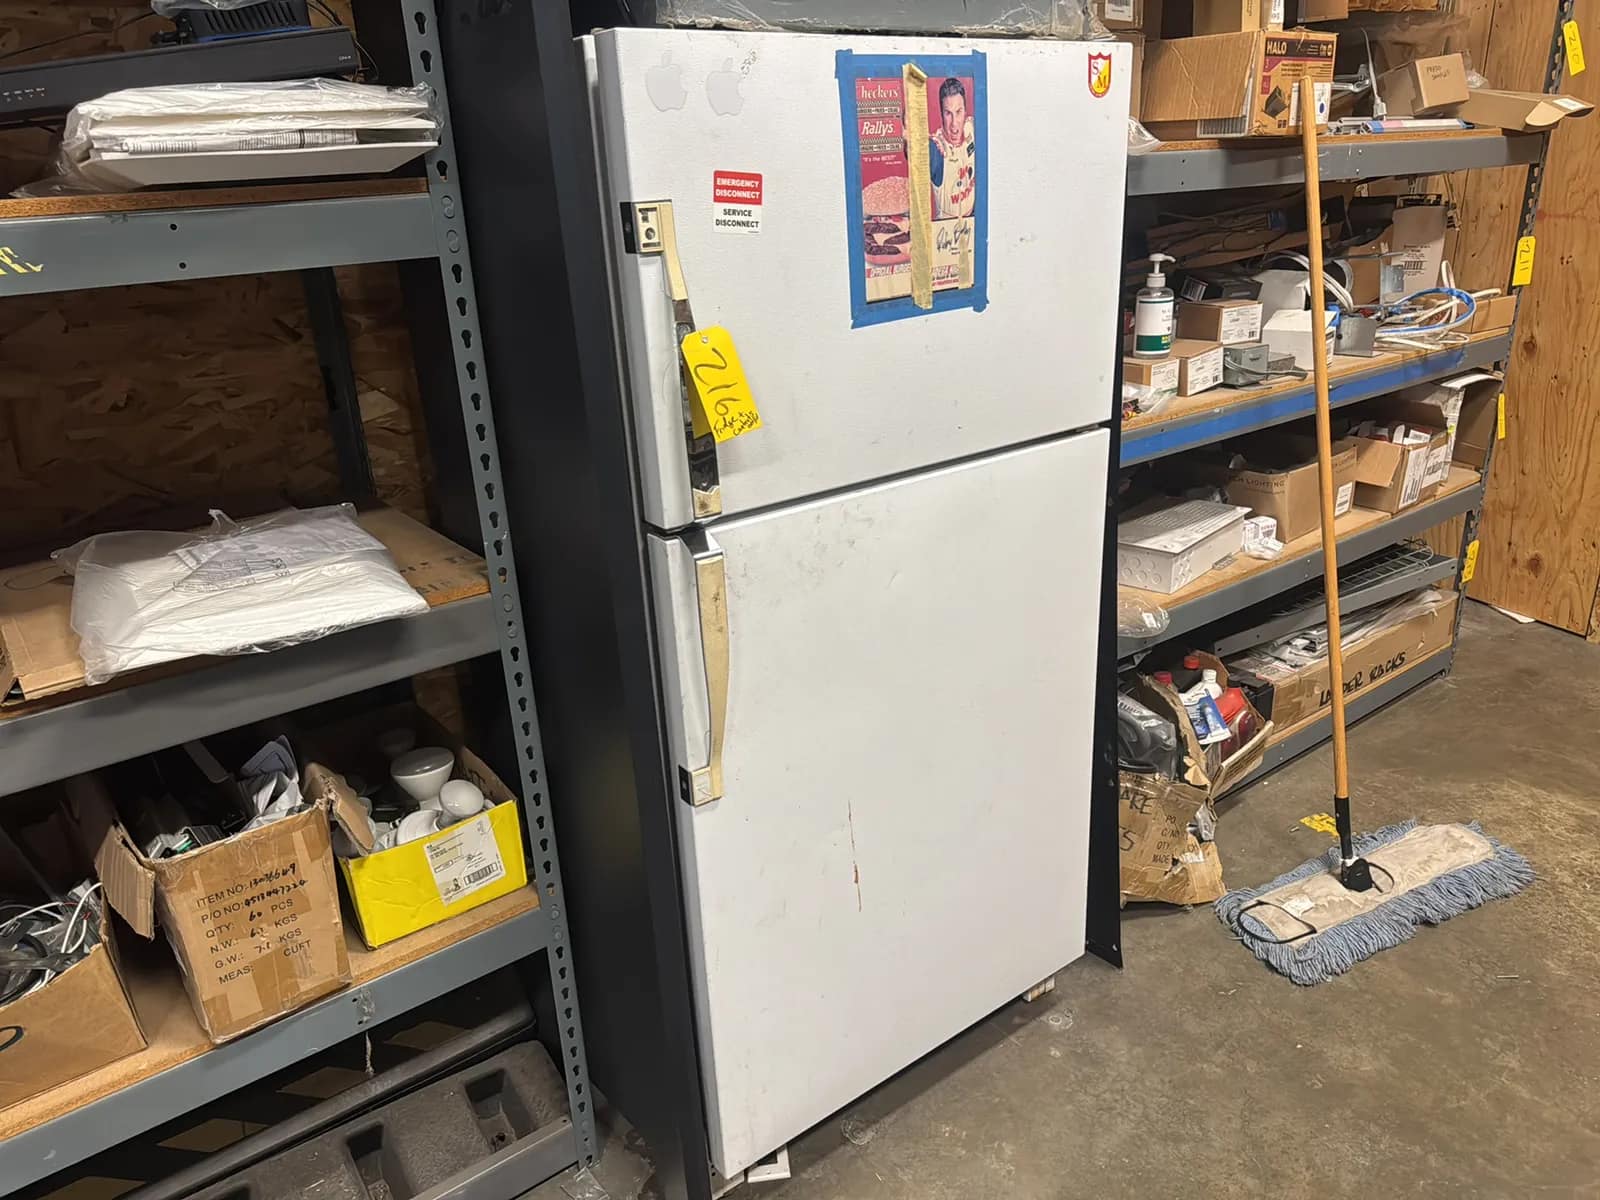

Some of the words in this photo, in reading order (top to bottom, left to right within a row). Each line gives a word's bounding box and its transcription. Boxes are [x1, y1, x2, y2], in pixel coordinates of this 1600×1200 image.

[1266, 41, 1287, 55] HALO
[861, 120, 895, 137] Rally's
[716, 177, 760, 188] EMERGENCY
[715, 188, 760, 199] DISCONNECT
[722, 208, 752, 217] SERVICE
[715, 218, 760, 228] DISCONNECT
[694, 347, 742, 417] 216
[1246, 477, 1285, 489] LIGHTING
[1319, 671, 1363, 707] LADER
[1369, 652, 1406, 683] RACKS
[197, 891, 226, 908] ITEM
[270, 898, 294, 913] PCS
[201, 909, 222, 924] P/O
[274, 913, 298, 928] KGS
[278, 928, 302, 944] KGS
[218, 964, 254, 984] MEAS:
[283, 939, 312, 957] CUFT
